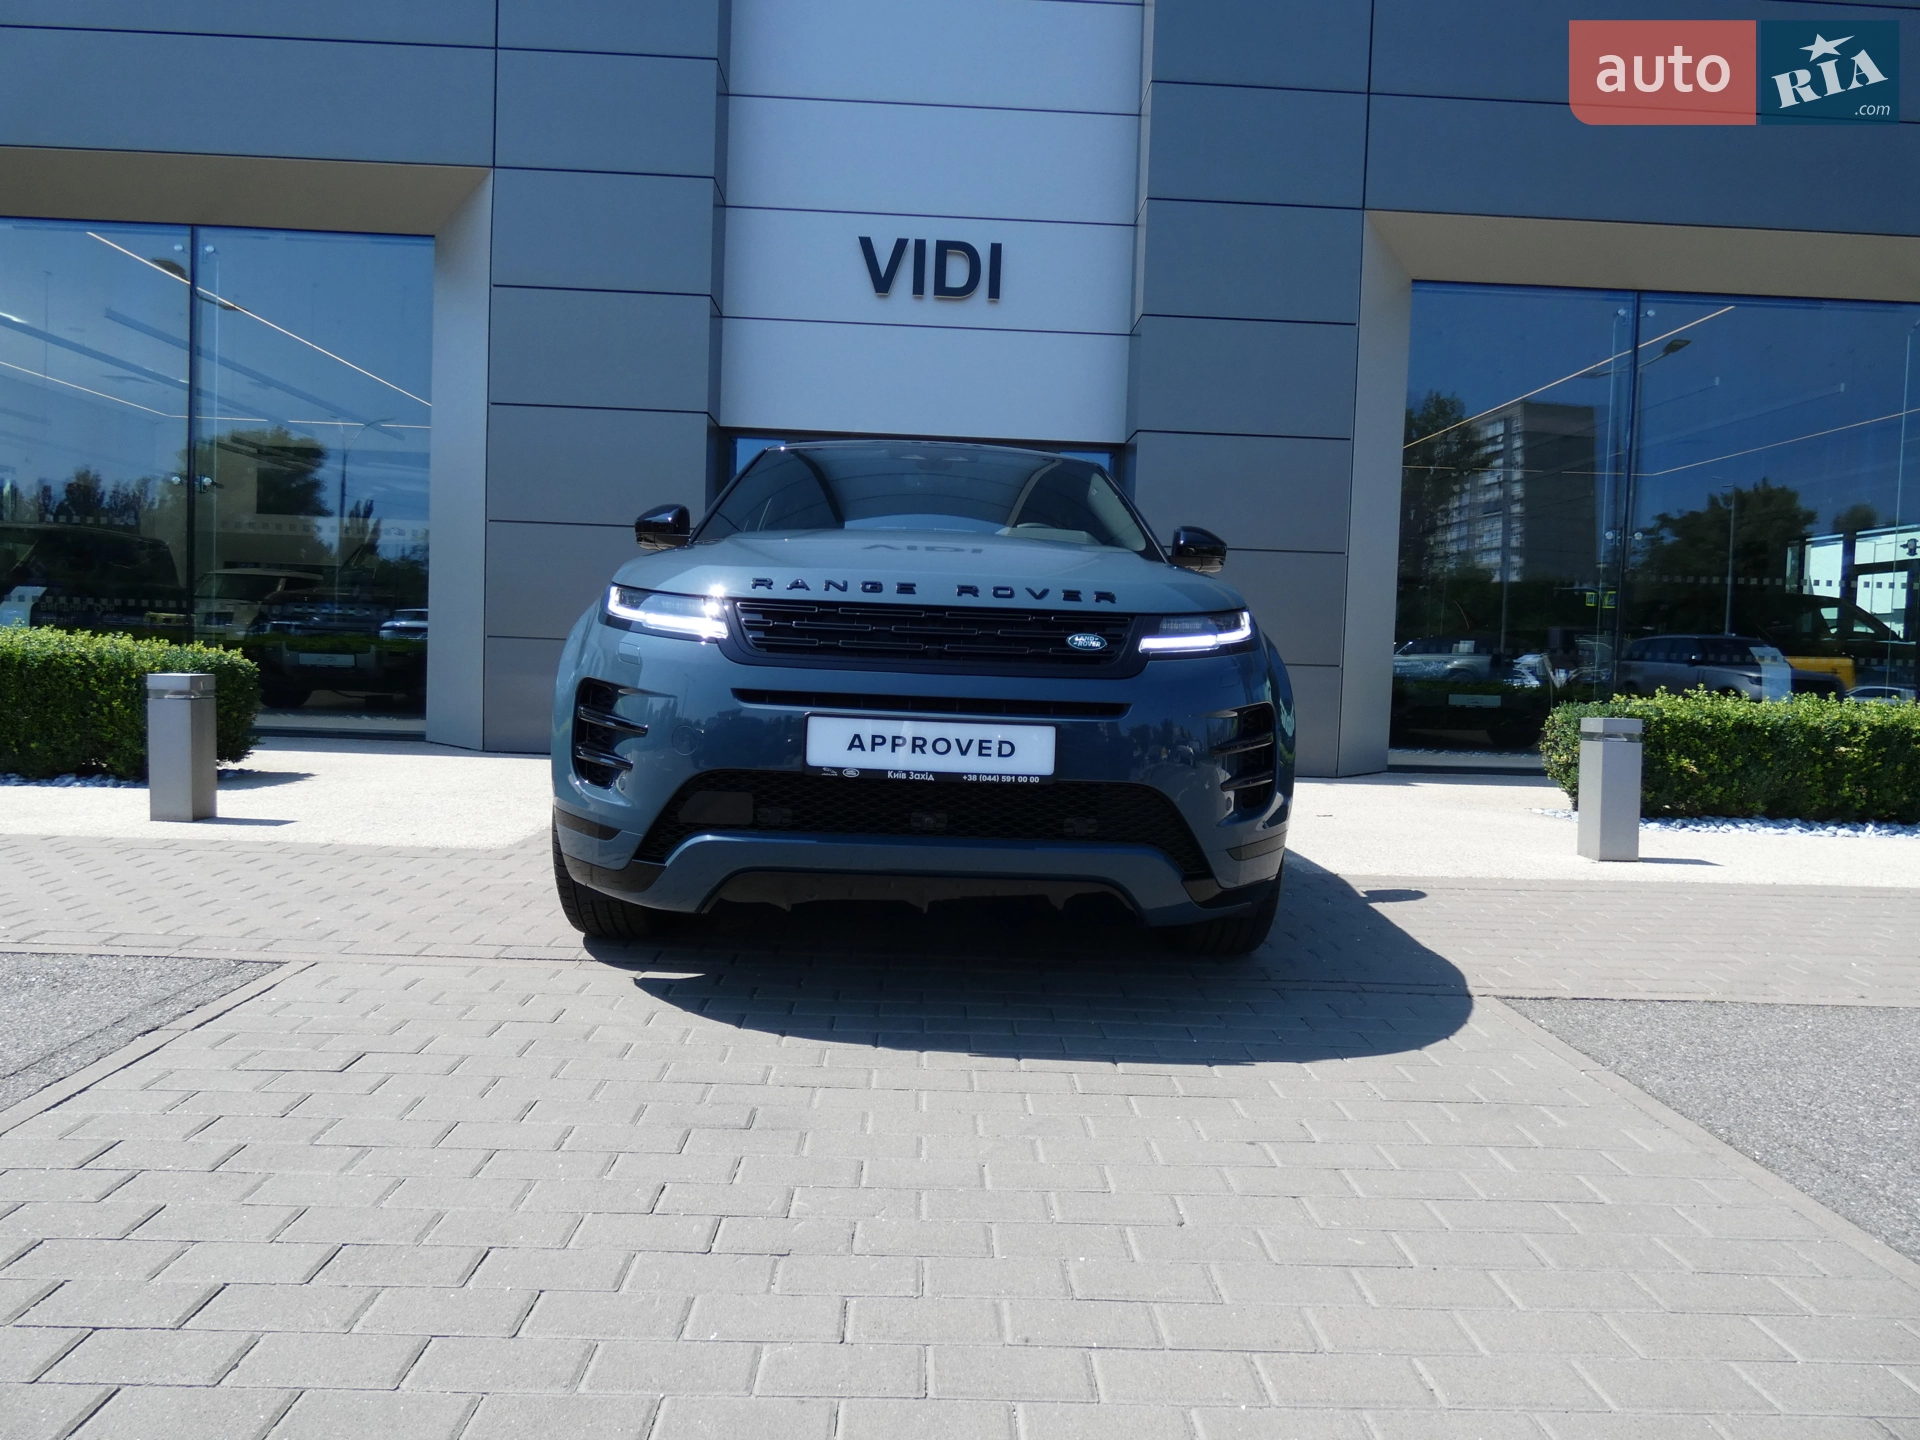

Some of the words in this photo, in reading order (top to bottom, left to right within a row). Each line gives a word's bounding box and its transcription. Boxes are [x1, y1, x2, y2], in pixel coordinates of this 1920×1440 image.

[858, 236, 1003, 302] VIDI
[751, 577, 917, 595] RANGE
[956, 584, 1117, 604] ROVER
[846, 733, 1016, 758] APPROVED
[887, 770, 907, 780] Київ
[908, 771, 935, 782] Захід
[962, 774, 978, 782] +38
[979, 773, 1000, 783] (044)
[1001, 775, 1016, 783] 591
[1017, 775, 1028, 784] 00
[1029, 775, 1040, 784] 00
